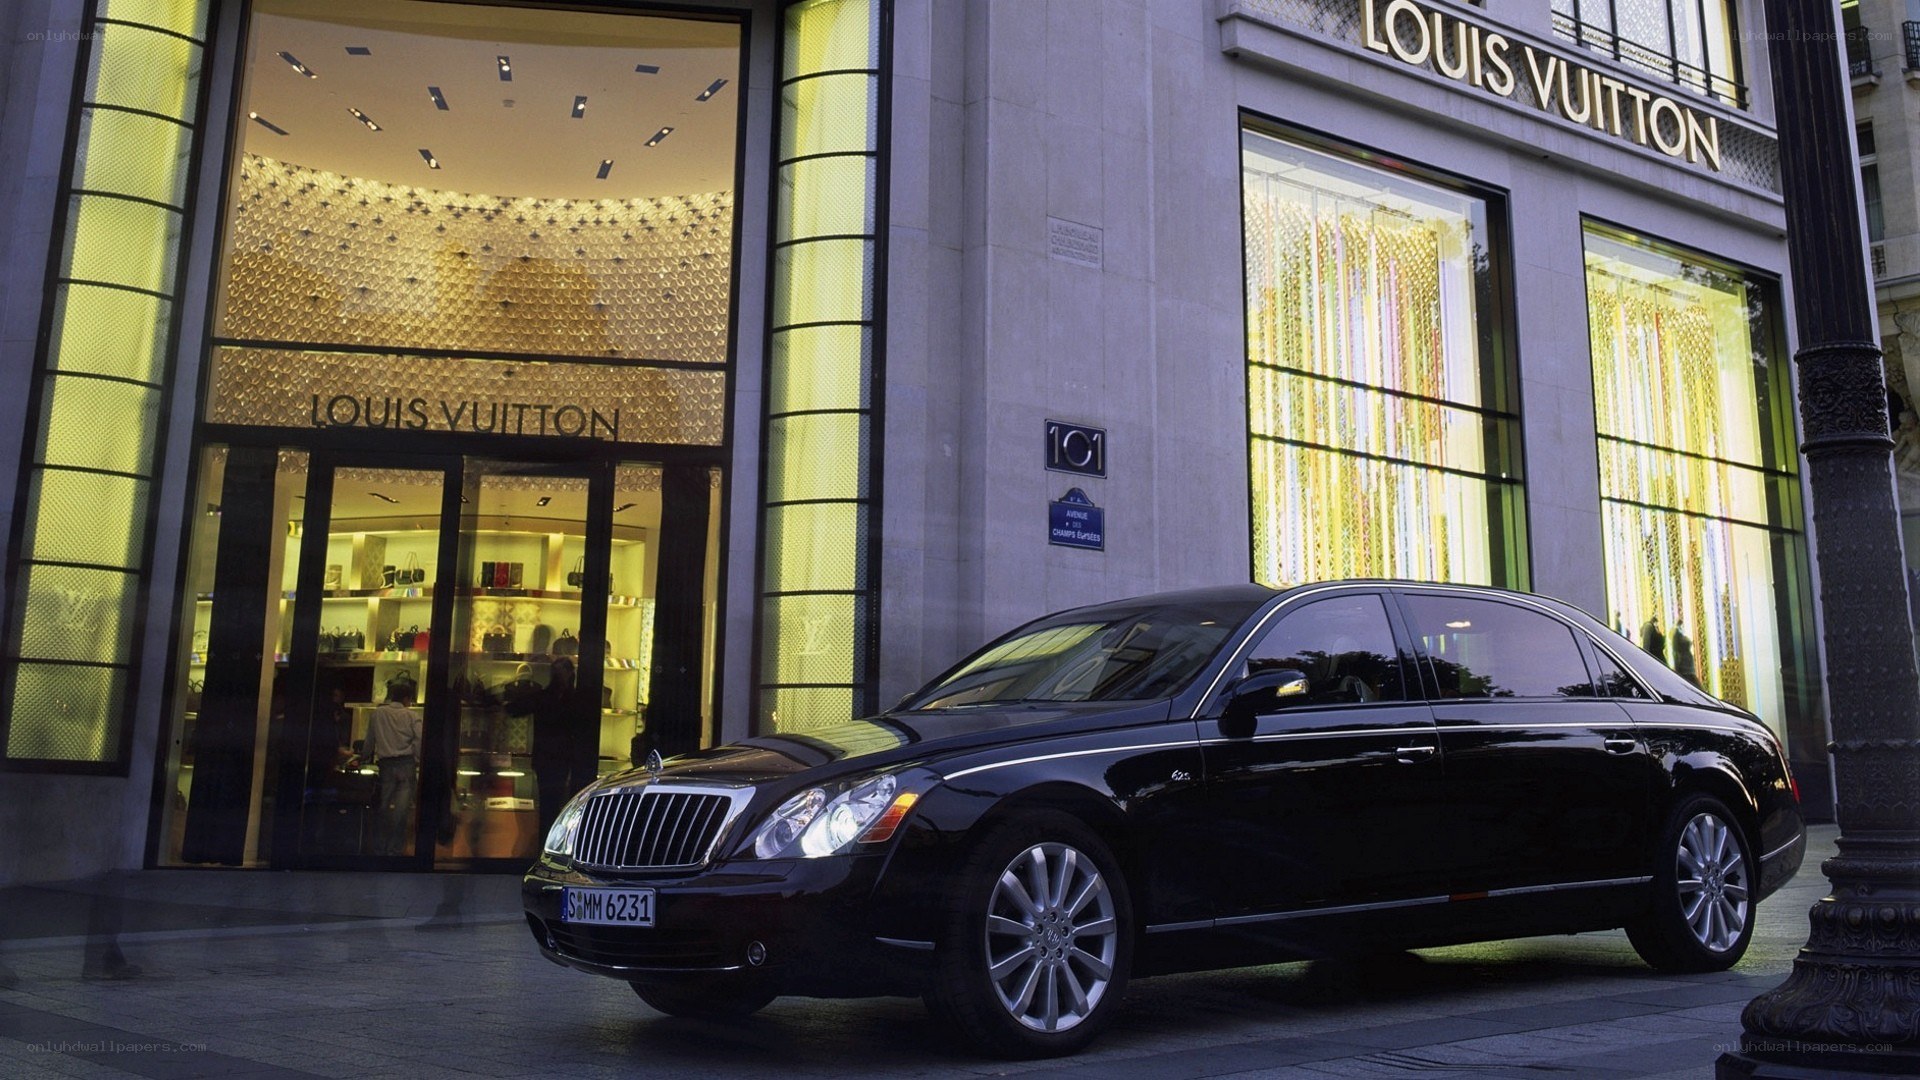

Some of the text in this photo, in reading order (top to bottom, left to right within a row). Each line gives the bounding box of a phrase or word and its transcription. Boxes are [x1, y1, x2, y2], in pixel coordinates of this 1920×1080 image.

[1361, 0, 1721, 172] LOUIS VUITTON
[311, 394, 620, 442] LOUIS VUITTON
[1049, 425, 1102, 471] 101
[1066, 509, 1088, 520] AVENUE
[1052, 528, 1076, 539] CHAMPS
[606, 893, 651, 922] 6231
